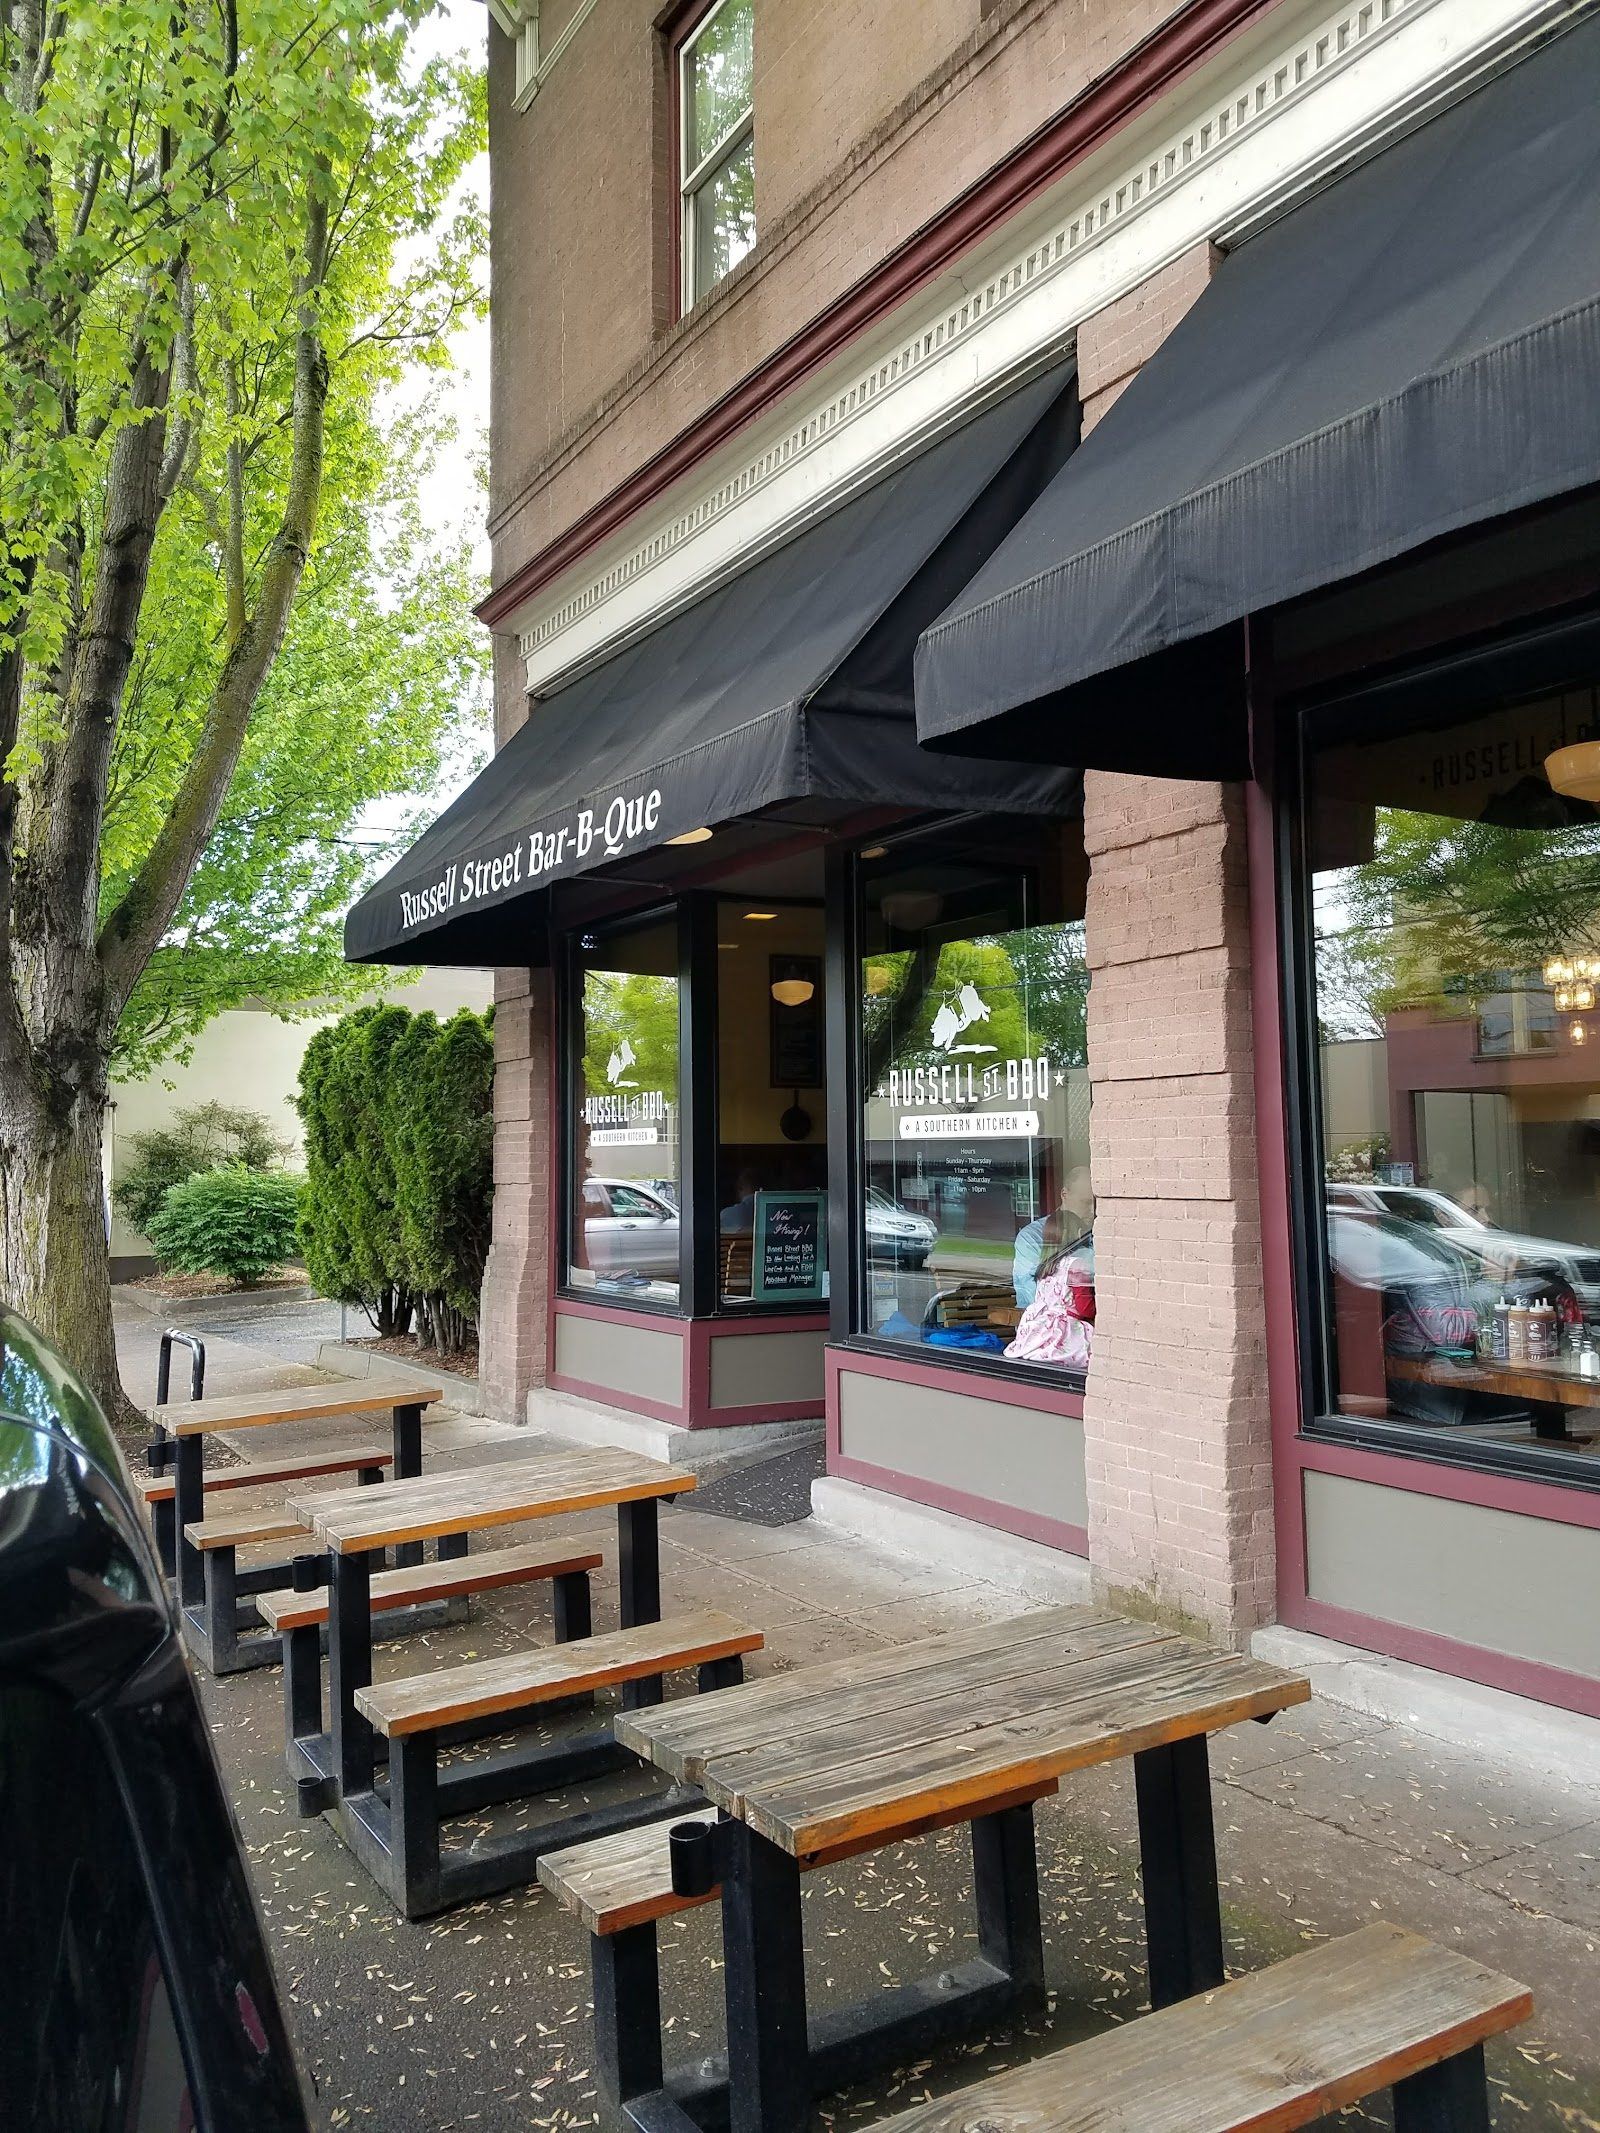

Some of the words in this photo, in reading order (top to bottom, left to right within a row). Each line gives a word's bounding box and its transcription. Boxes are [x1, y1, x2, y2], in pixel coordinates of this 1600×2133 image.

[1433, 735, 1542, 791] RUSSELL
[400, 863, 457, 929] Russell
[459, 841, 522, 904] Street
[528, 789, 662, 878] Bar-B-Que
[889, 1063, 978, 1107] RUSSELL
[983, 1067, 1001, 1097] ST.
[1006, 1057, 1049, 1100] BBQ
[586, 1094, 629, 1124] RUSSELL
[642, 1091, 662, 1120] BBQ
[915, 1121, 920, 1132] A
[924, 1118, 970, 1132] SOUTHERN
[976, 1117, 1018, 1131] KITCHEN
[602, 1133, 626, 1142] SOUTHERN
[628, 1132, 648, 1140] KITCHEN
[946, 1157, 965, 1165] Sunday
[968, 1157, 992, 1165] Thursday
[947, 1176, 964, 1184] Friday
[967, 1176, 991, 1184] Saturday
[770, 1209, 793, 1222] Now
[784, 1244, 800, 1253] Street
[802, 1243, 814, 1252] BBQ
[788, 1274, 814, 1284] Manager
